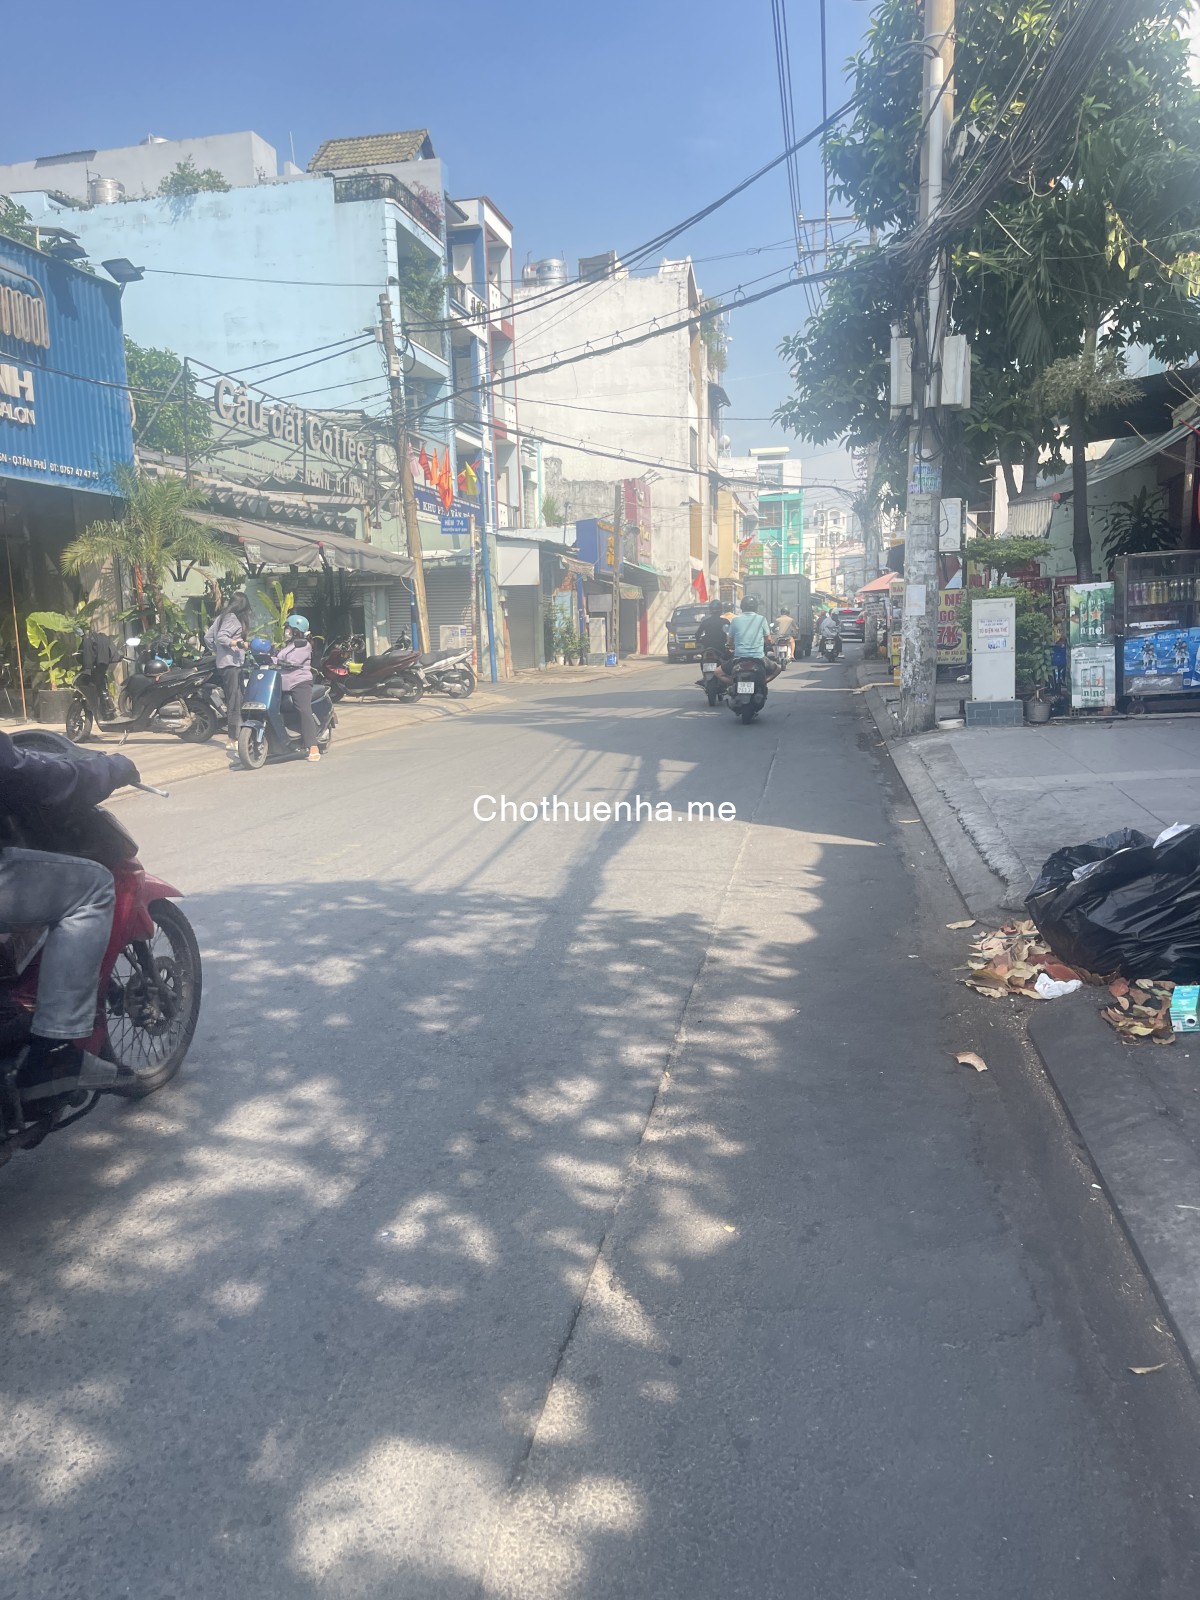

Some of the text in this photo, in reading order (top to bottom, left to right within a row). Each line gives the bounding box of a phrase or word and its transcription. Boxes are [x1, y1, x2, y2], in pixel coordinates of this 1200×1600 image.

[214, 379, 264, 429] Cầu
[305, 416, 366, 465] Coffee
[60, 465, 73, 475] 0767
[75, 468, 83, 477] 47
[456, 519, 464, 527] 74
